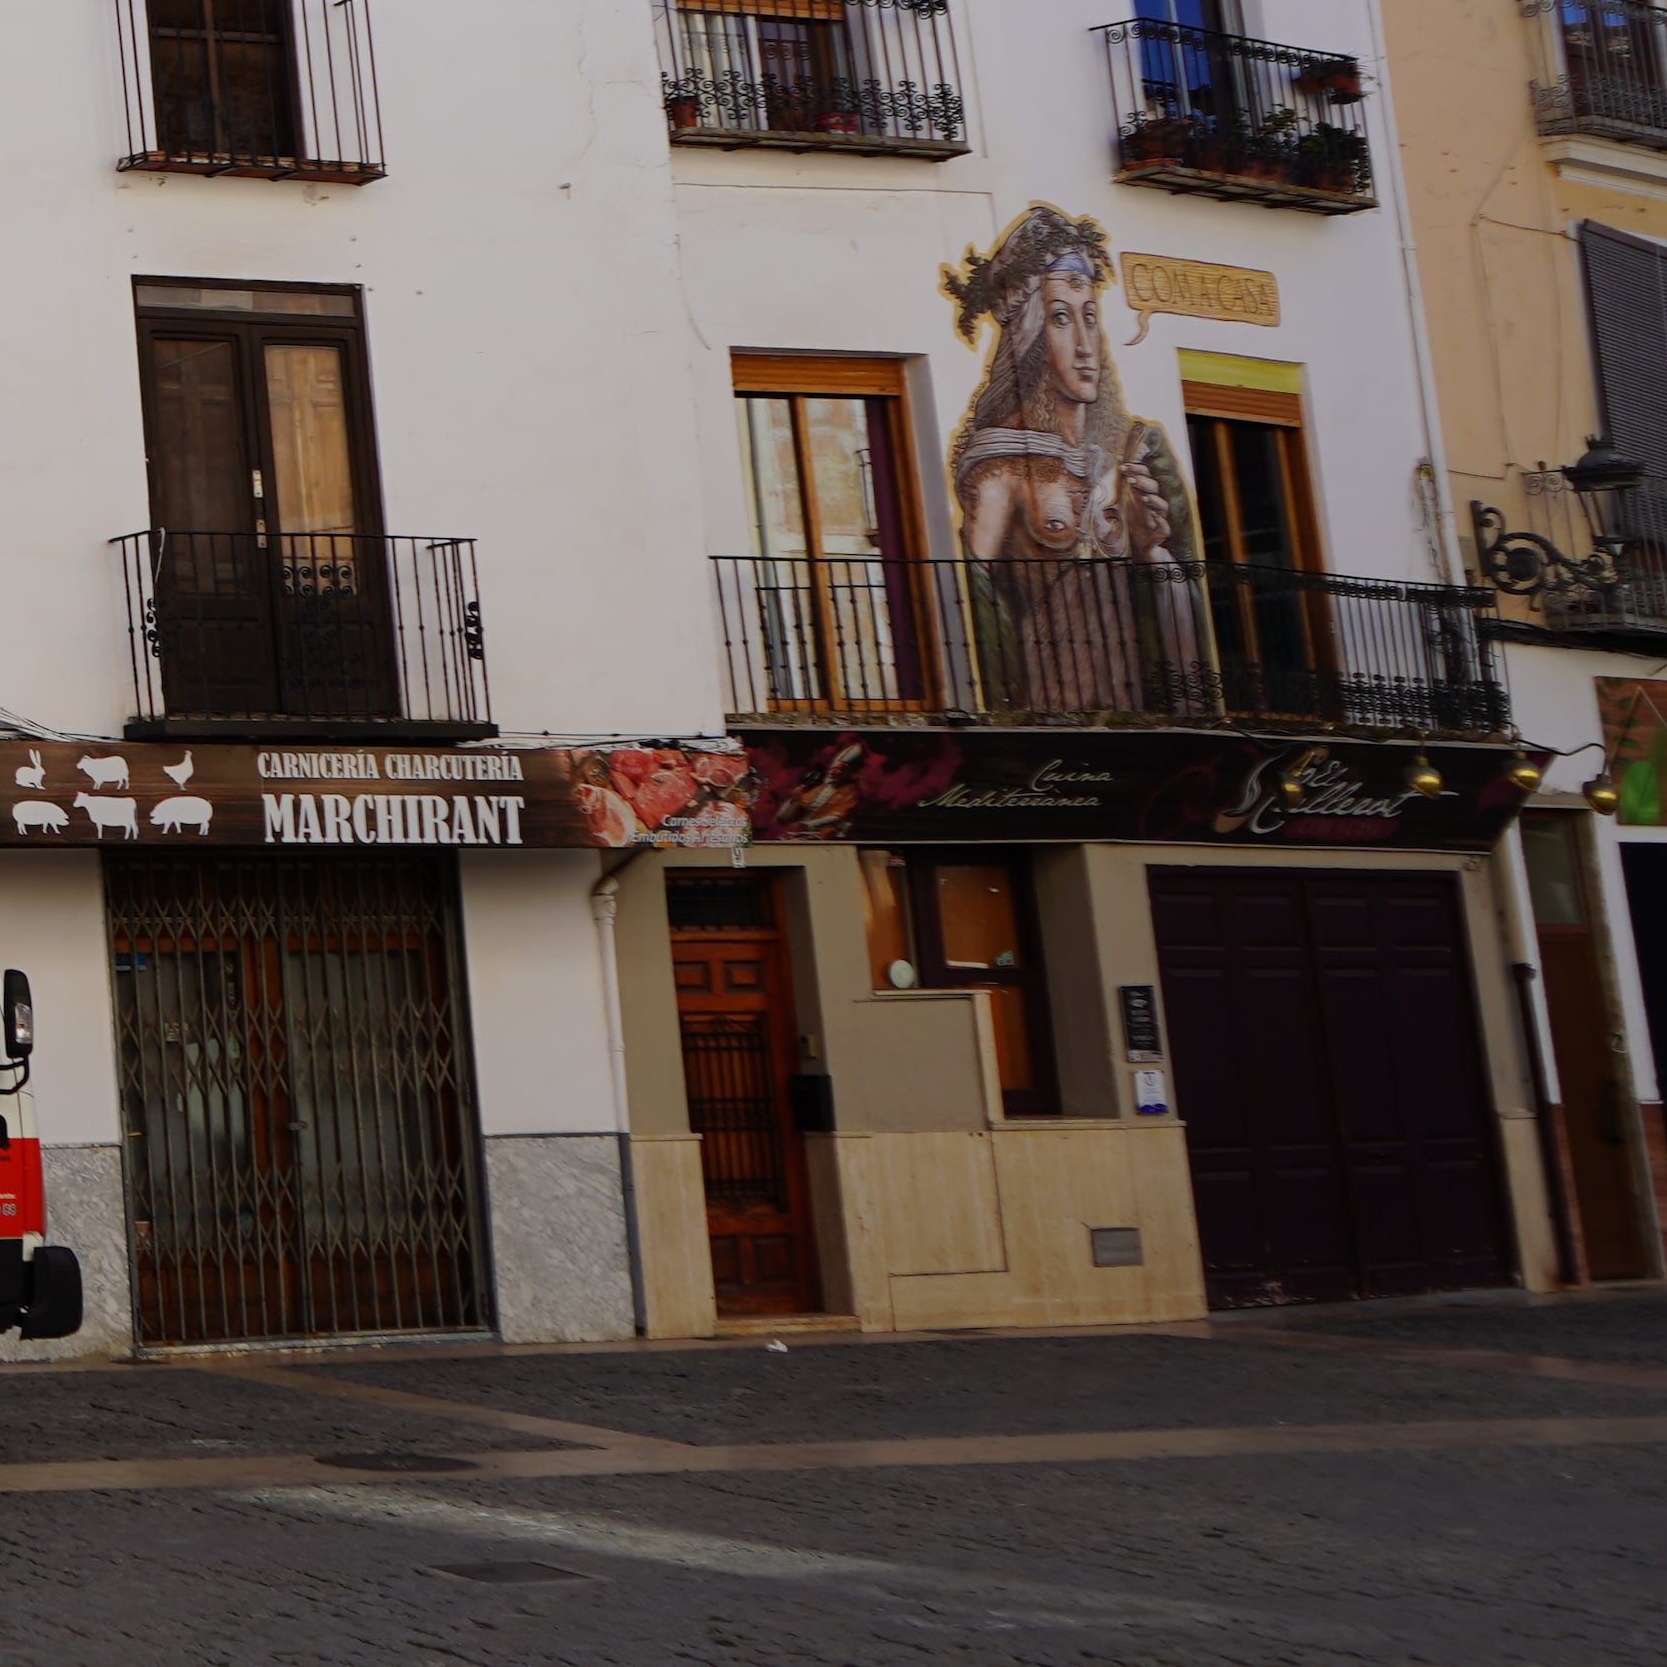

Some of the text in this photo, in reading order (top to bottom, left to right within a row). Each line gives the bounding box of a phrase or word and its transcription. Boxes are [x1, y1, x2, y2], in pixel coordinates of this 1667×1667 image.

[257, 749, 524, 781] CARNICERÍA CHARCUTERÍA
[1029, 758, 1114, 792] Cuina
[261, 793, 525, 845] MARCHIRANT
